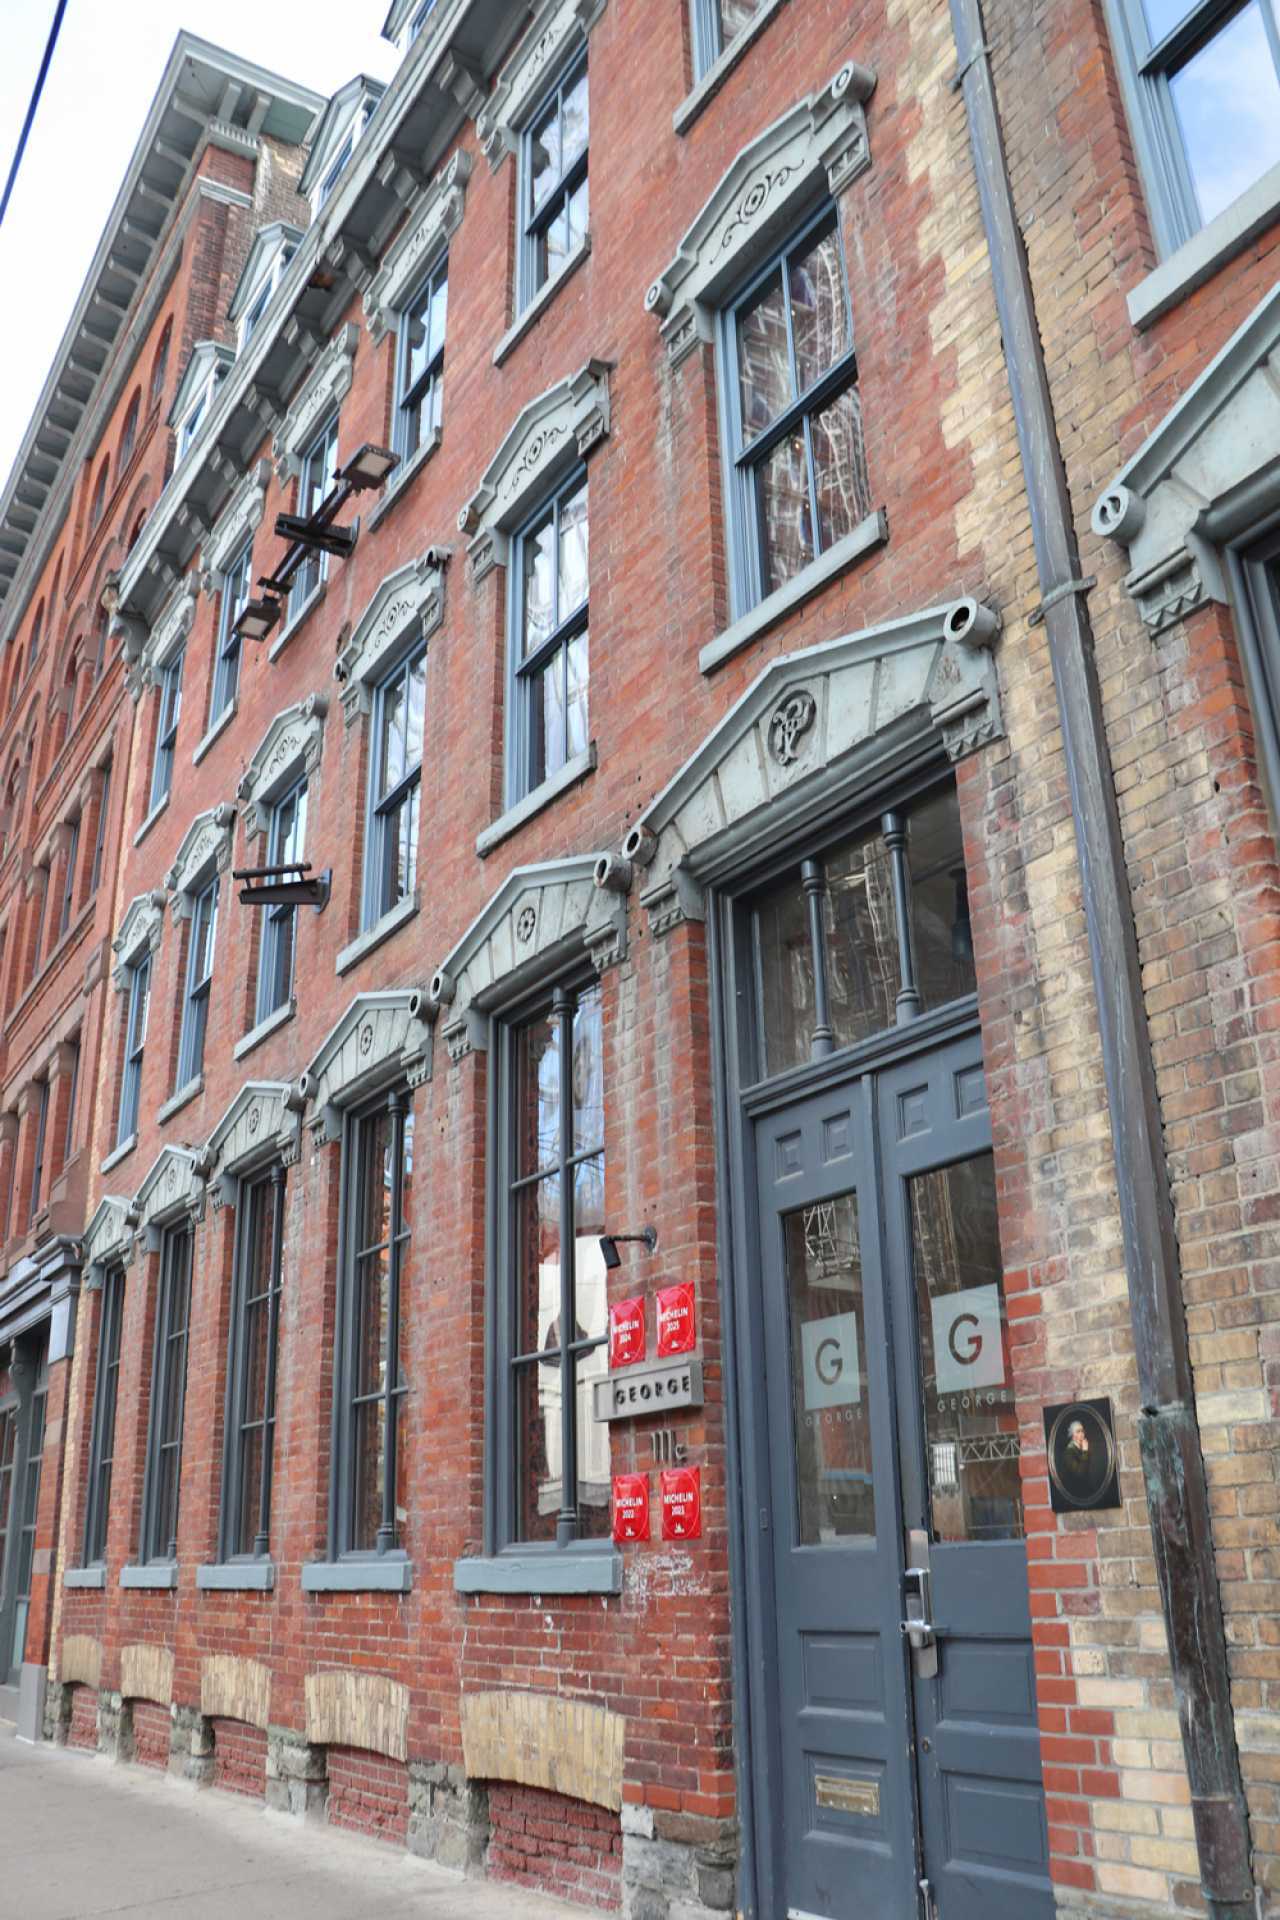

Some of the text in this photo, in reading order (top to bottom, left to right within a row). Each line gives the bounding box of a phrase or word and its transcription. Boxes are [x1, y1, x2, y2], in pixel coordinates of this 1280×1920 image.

[659, 1307, 689, 1322] MICHELIN
[611, 1320, 640, 1334] MICHELIN
[949, 1313, 983, 1366] G
[815, 1338, 843, 1386] G
[615, 1376, 690, 1405] GEORGE
[937, 1390, 1008, 1413] GEORGE
[804, 1408, 863, 1427] GEORGE
[616, 1497, 643, 1508] MICHELIN
[663, 1492, 693, 1504] MICHELIN
